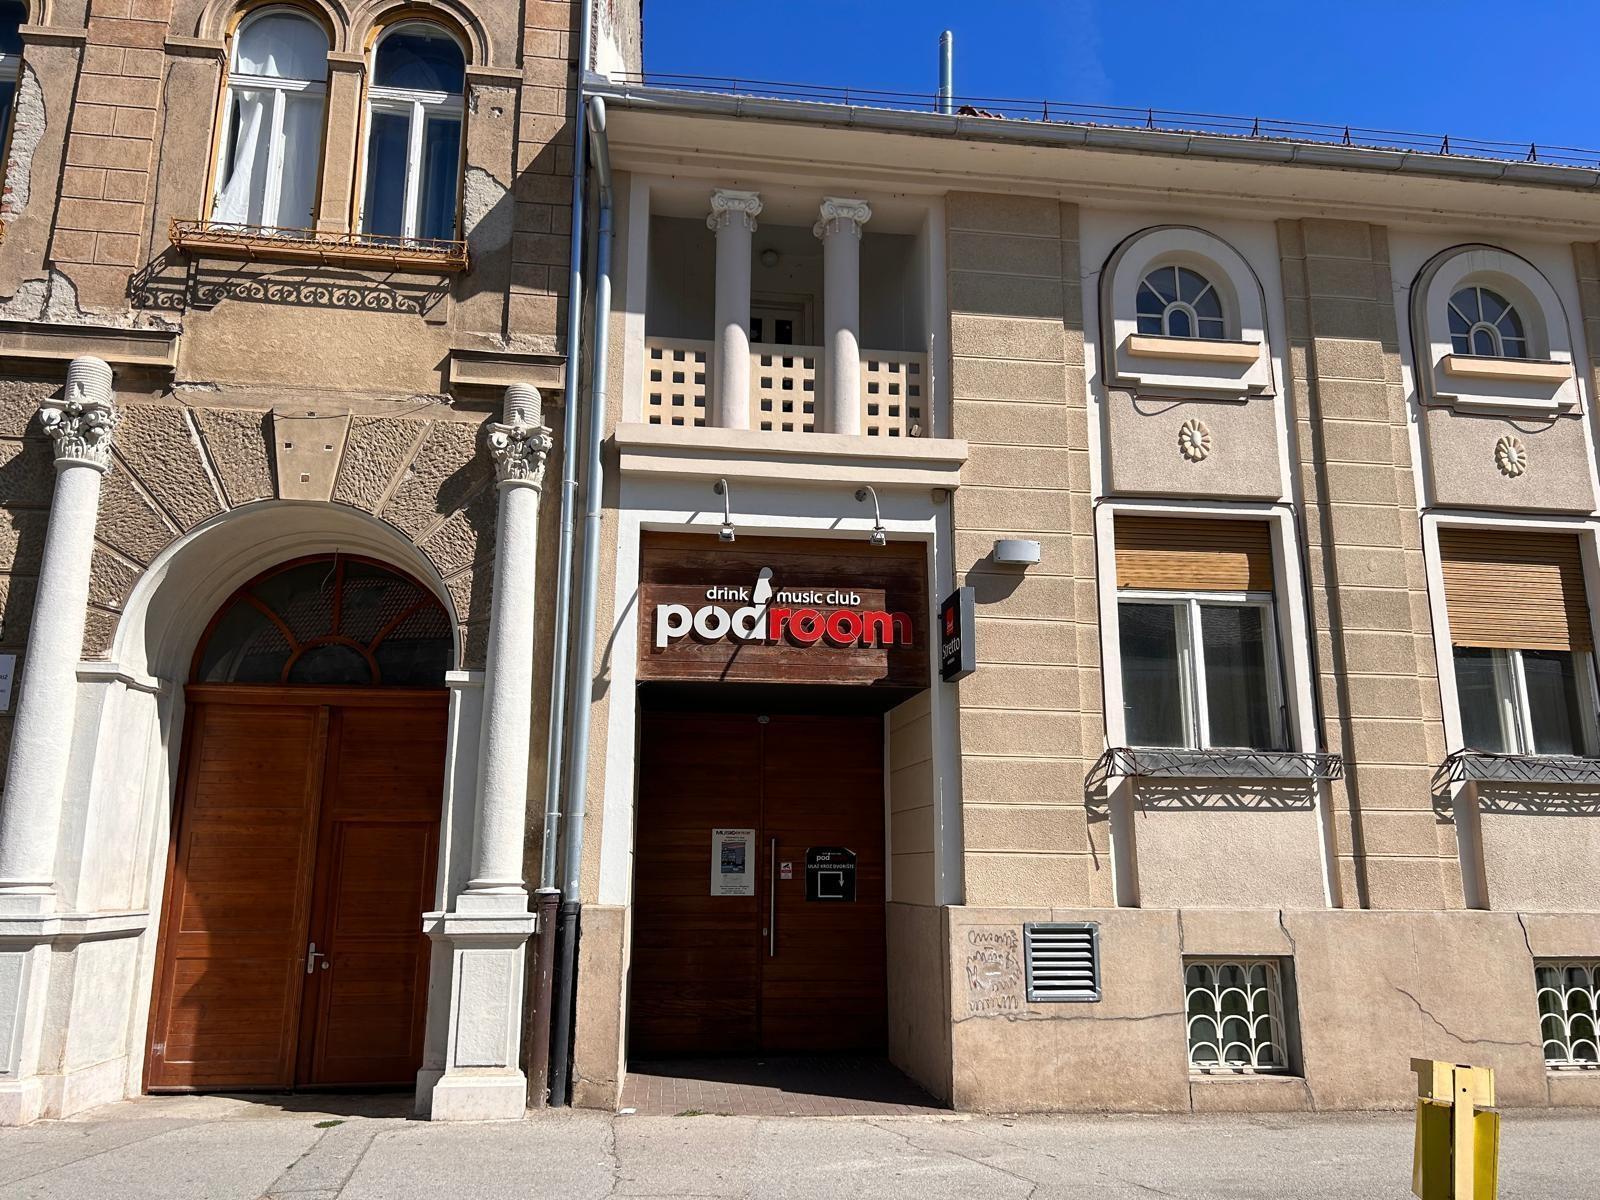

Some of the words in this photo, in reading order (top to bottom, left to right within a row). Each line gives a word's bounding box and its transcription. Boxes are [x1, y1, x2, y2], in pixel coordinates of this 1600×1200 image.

[706, 586, 749, 601] drink
[776, 590, 823, 604] music
[826, 591, 861, 606] club
[942, 638, 960, 660] Stretto
